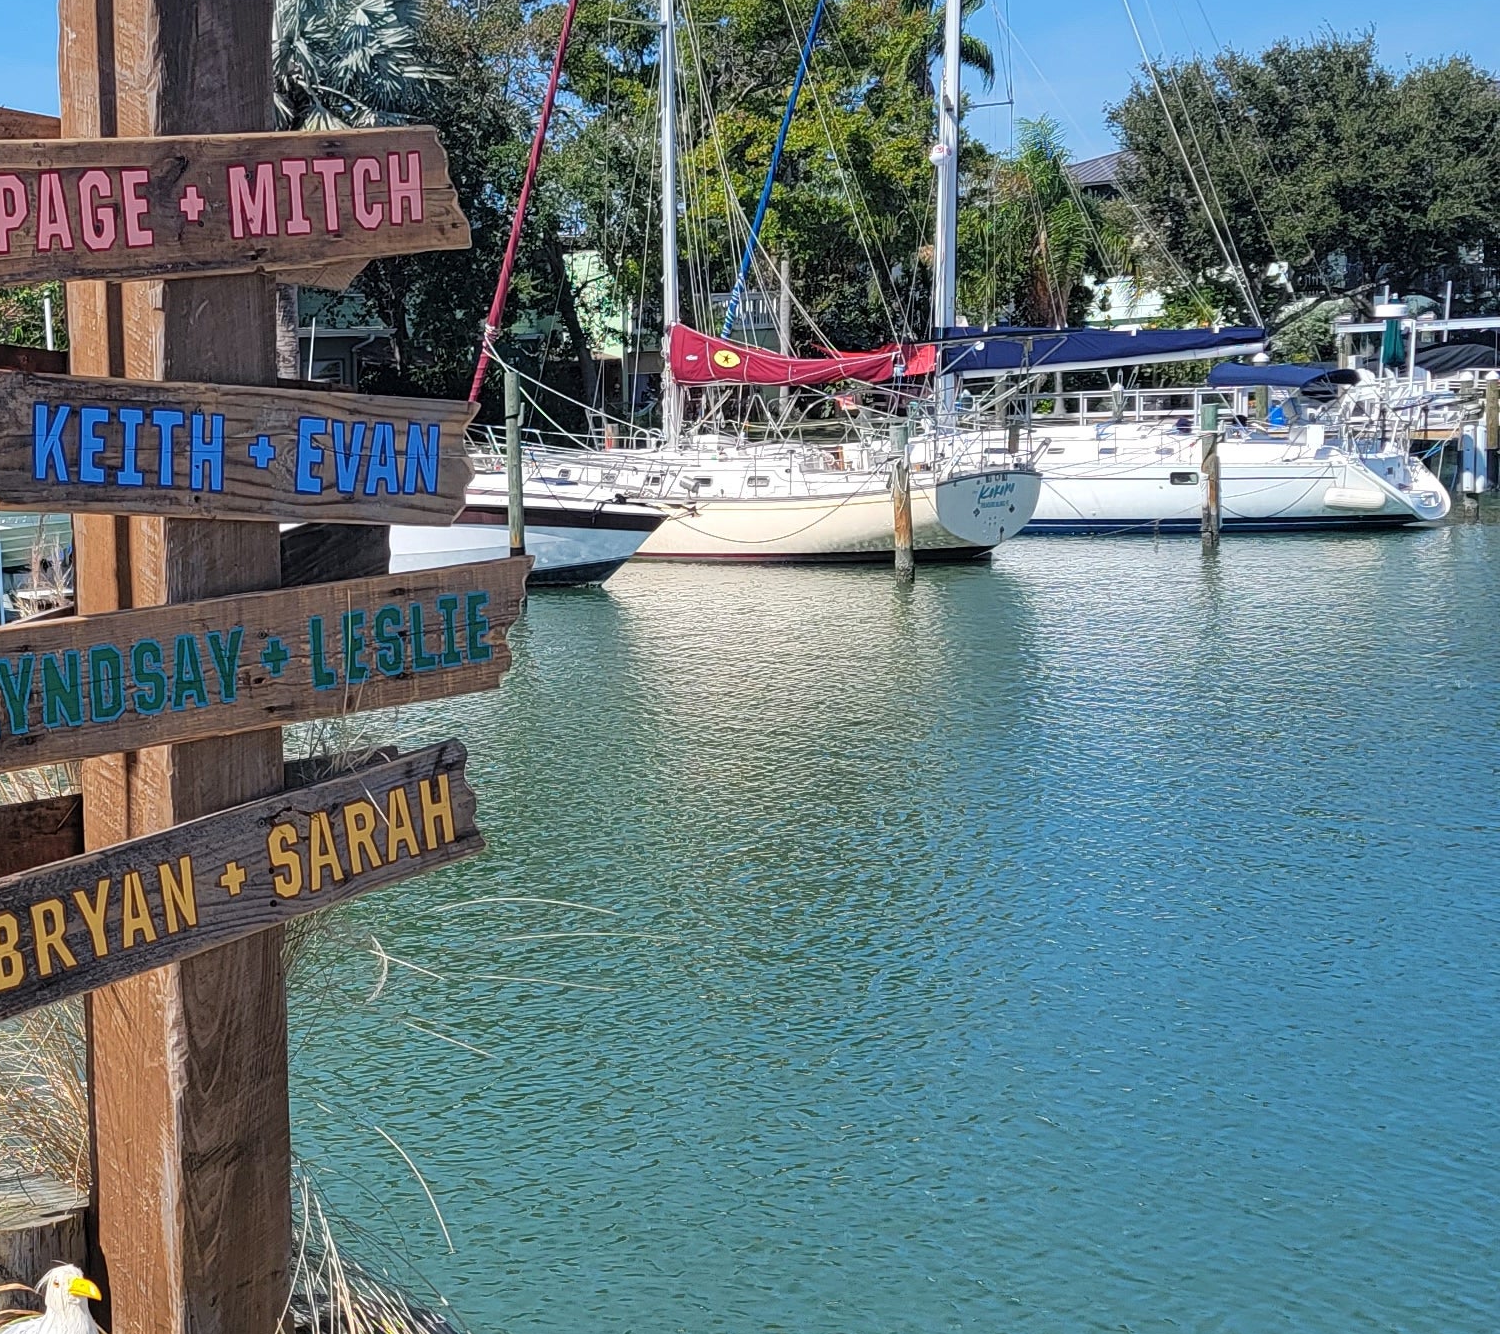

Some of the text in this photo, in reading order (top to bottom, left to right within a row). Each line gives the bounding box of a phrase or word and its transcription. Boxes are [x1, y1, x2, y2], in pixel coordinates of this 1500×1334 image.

[227, 150, 424, 240] MITCH
[31, 401, 225, 493] KEITH
[294, 416, 441, 496] EVAN
[308, 590, 493, 691] LESLIE
[267, 772, 457, 898] SARAH
